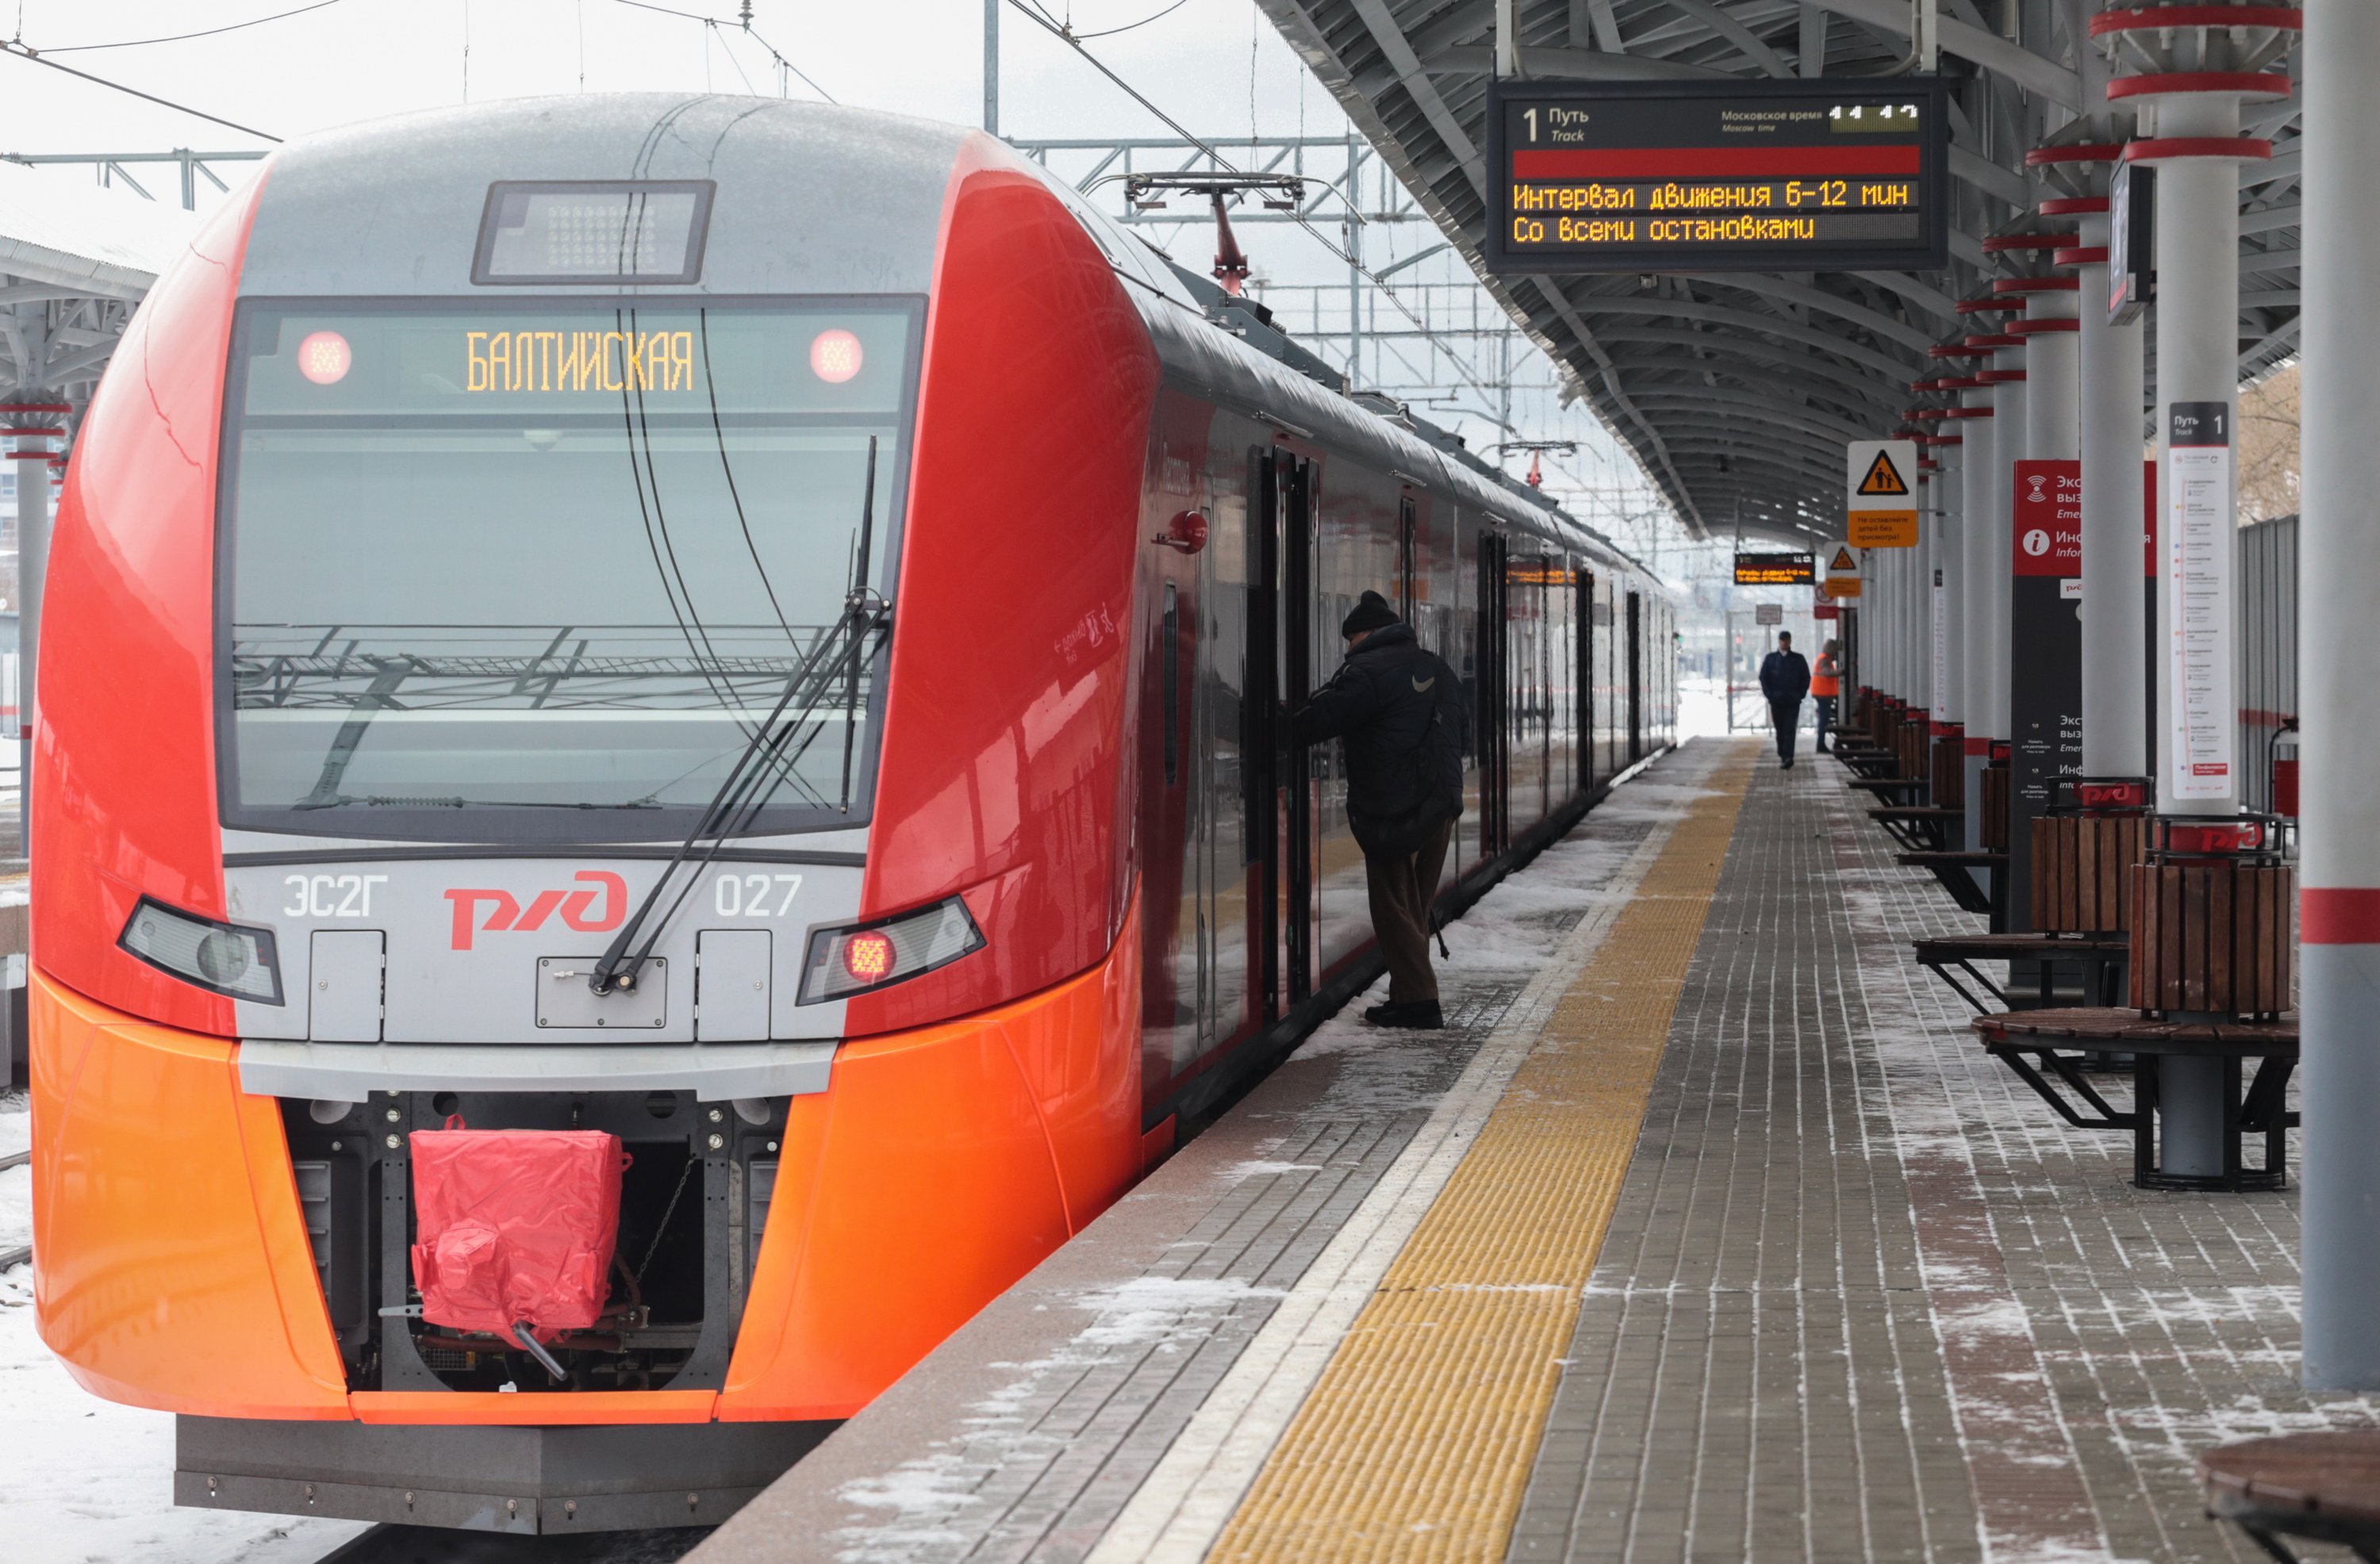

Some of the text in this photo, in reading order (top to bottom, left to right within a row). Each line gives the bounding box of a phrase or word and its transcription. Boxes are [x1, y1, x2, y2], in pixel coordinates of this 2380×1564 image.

[1522, 108, 1589, 142] 1 Путь
[1722, 110, 1822, 123] Московское время
[1552, 129, 1584, 142] Track
[1722, 124, 1775, 132] Moscow time
[1514, 183, 1634, 211] Интервал
[1650, 183, 1771, 210] движения
[1862, 186, 1908, 205] мин
[1514, 215, 1814, 242] Со всеми остановками
[466, 332, 693, 391] БАЛТИЙСКАЯ
[2174, 415, 2222, 435] Путь 1
[2060, 730, 2082, 738] выз
[2059, 765, 2082, 776] Инф
[283, 875, 388, 917] ЭС2Г
[716, 874, 803, 917] 027
